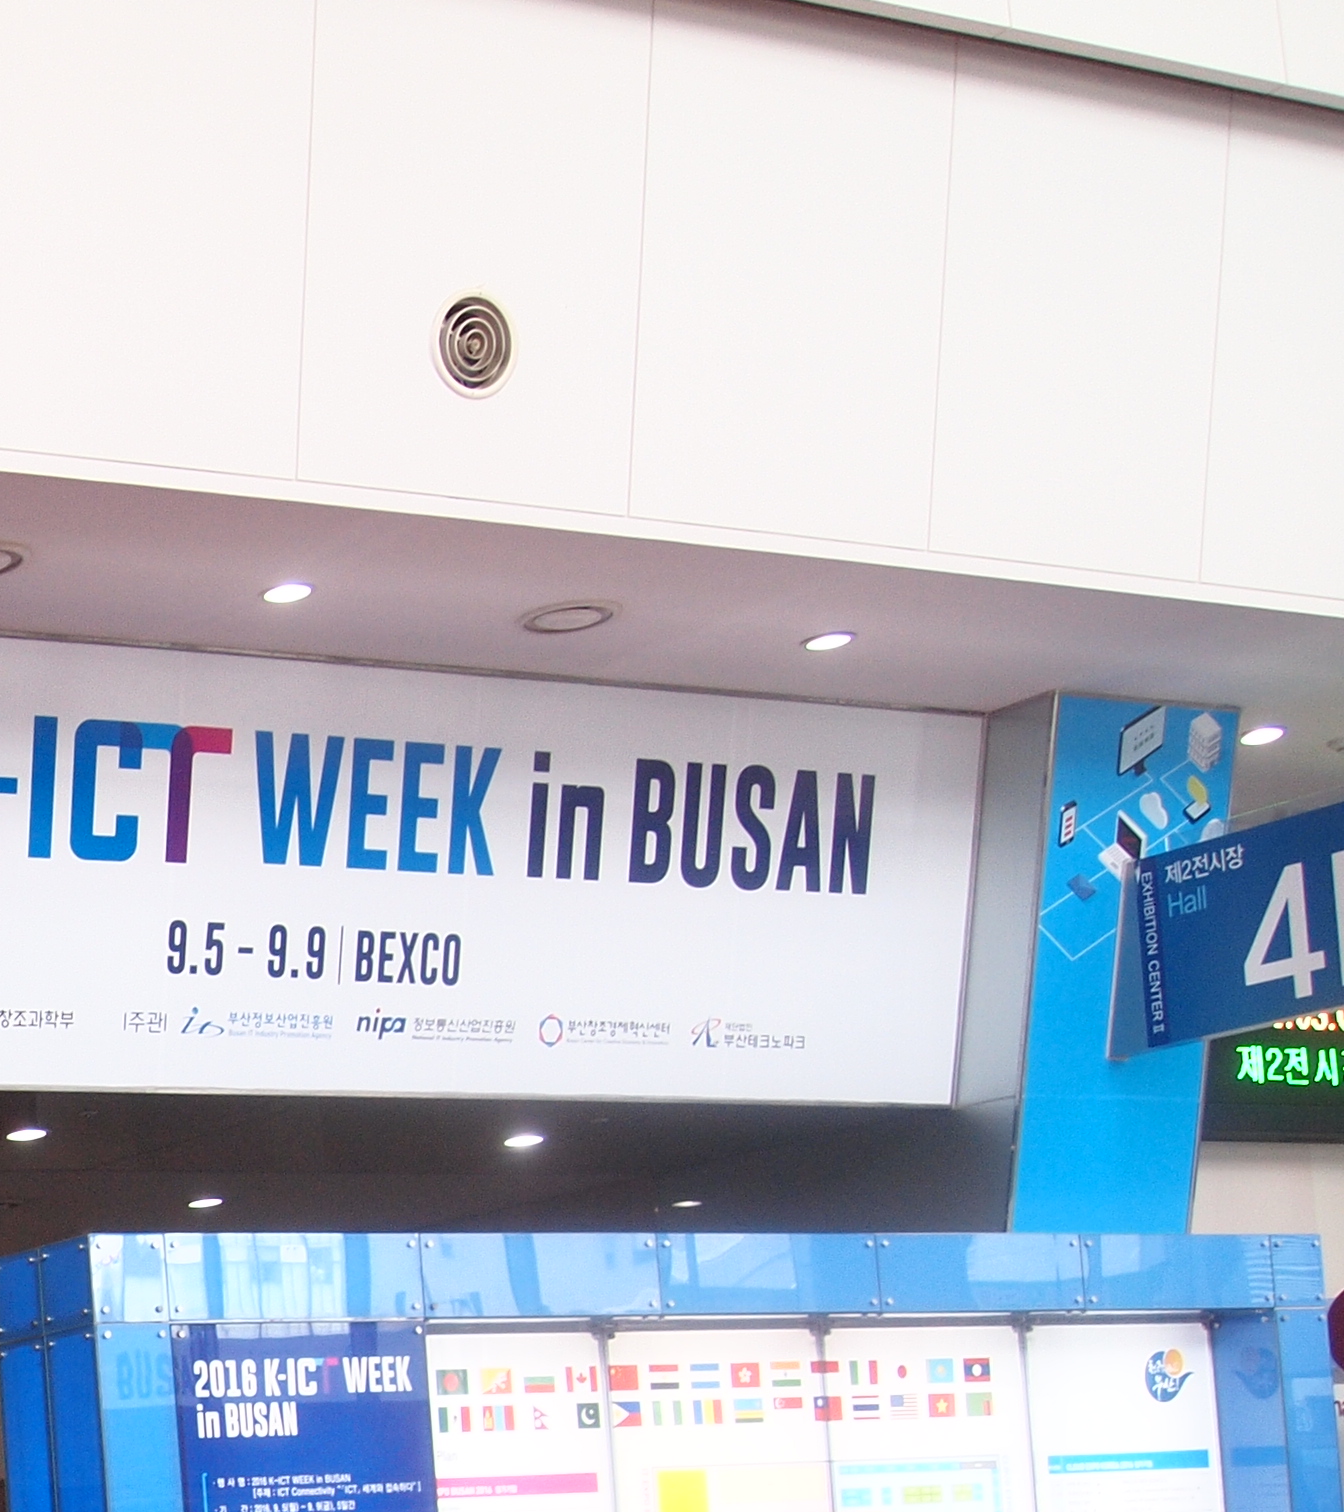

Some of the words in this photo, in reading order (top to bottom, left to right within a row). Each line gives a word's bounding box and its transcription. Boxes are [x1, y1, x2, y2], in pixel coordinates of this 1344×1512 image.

[255, 730, 502, 878] WEEK
[526, 752, 603, 882] in
[629, 759, 875, 896] BUSAN
[1164, 844, 1244, 884] 제2전시장
[1139, 871, 1158, 956] EXHIBITION
[1168, 885, 1207, 918] Hall
[354, 929, 462, 987] BEXCO
[1147, 960, 1164, 1021] CENTER
[228, 1011, 334, 1030] 부산정보산업진흥원
[356, 1007, 406, 1039] nipa
[413, 1017, 516, 1034] 정보통신산업진흥원
[724, 1034, 805, 1049] 부산테크노파크
[1235, 1045, 1344, 1087] 제2전시
[193, 1358, 258, 1398] 2016
[263, 1356, 339, 1397] K-ICT
[342, 1355, 413, 1393] WEEK
[196, 1404, 220, 1438] in
[224, 1401, 298, 1438] BUSAN
